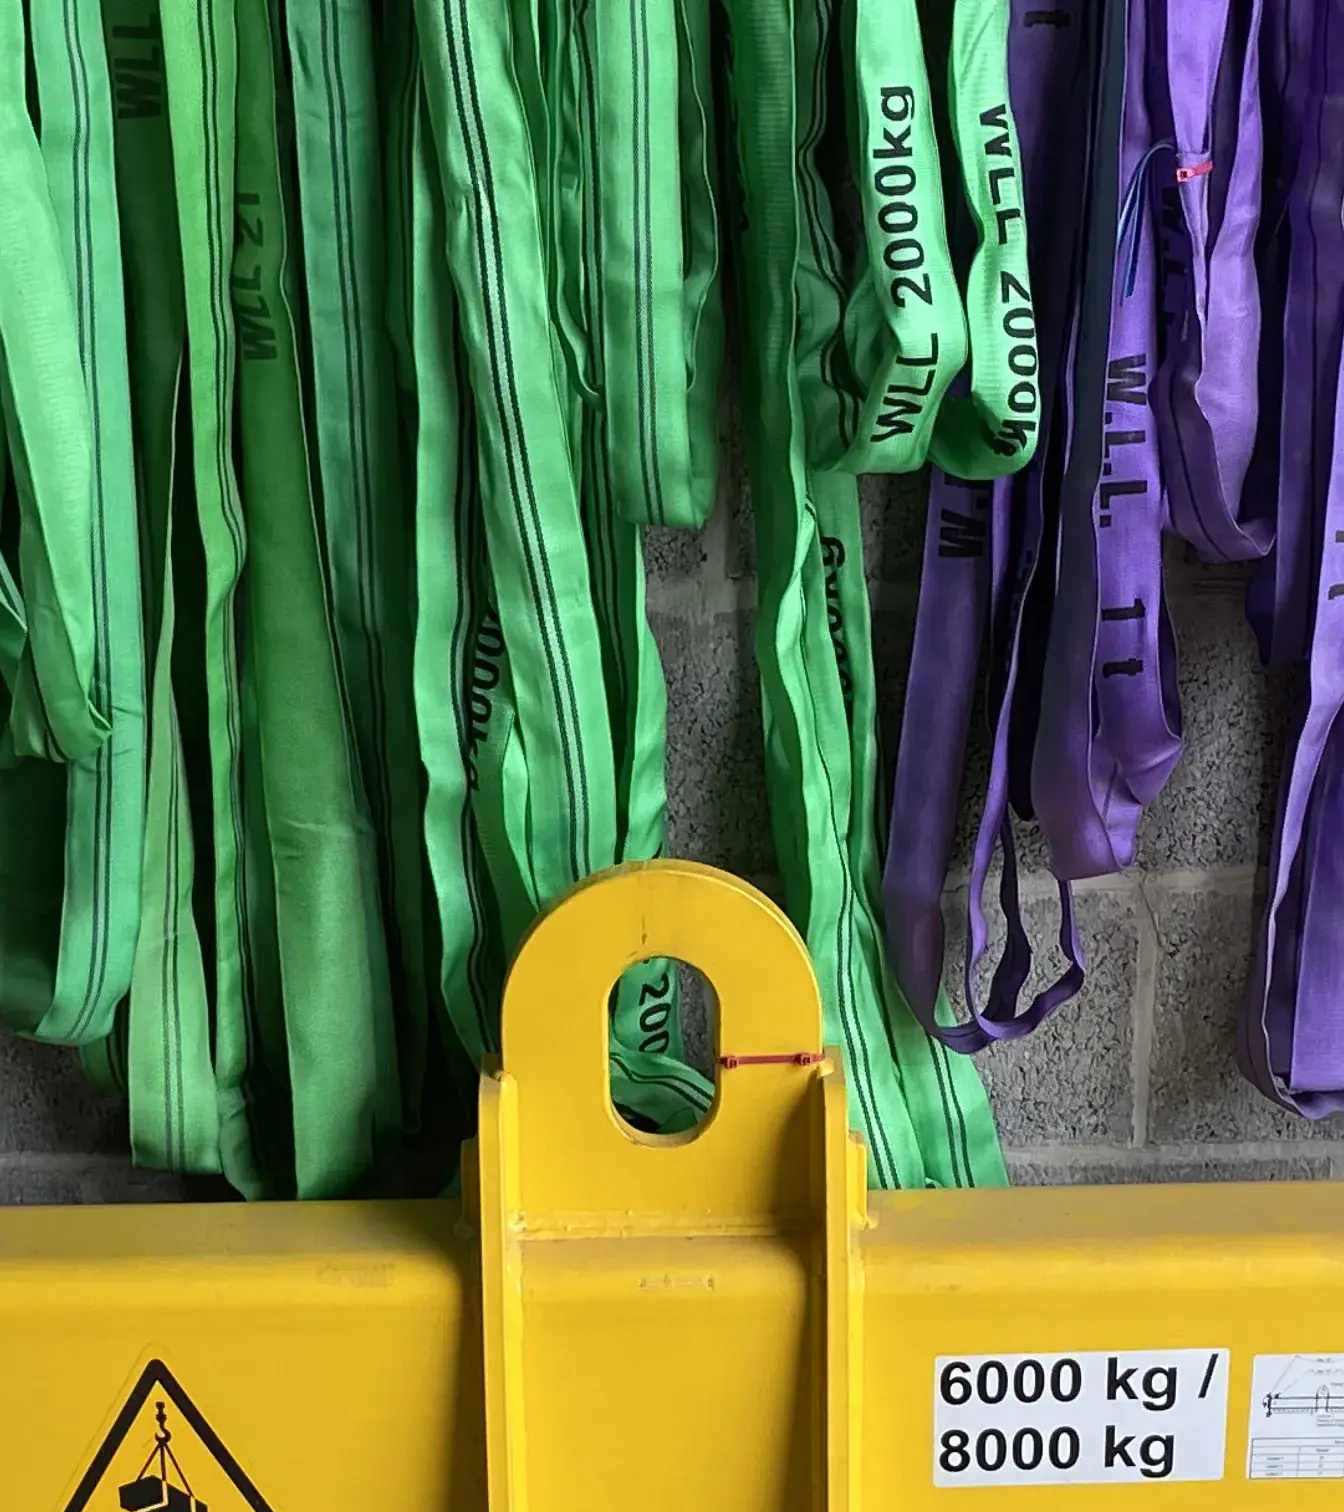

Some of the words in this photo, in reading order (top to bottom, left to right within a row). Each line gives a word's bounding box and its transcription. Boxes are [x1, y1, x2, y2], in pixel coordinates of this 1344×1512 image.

[873, 85, 934, 309] 2000kg
[979, 103, 1022, 246] WLL
[870, 333, 938, 443] WLL
[1099, 353, 1149, 528] W.L.L.
[940, 1358, 1082, 1406] 6000
[1106, 1357, 1177, 1412] kg
[939, 1426, 1080, 1473] 8000
[1104, 1425, 1174, 1479] kg
